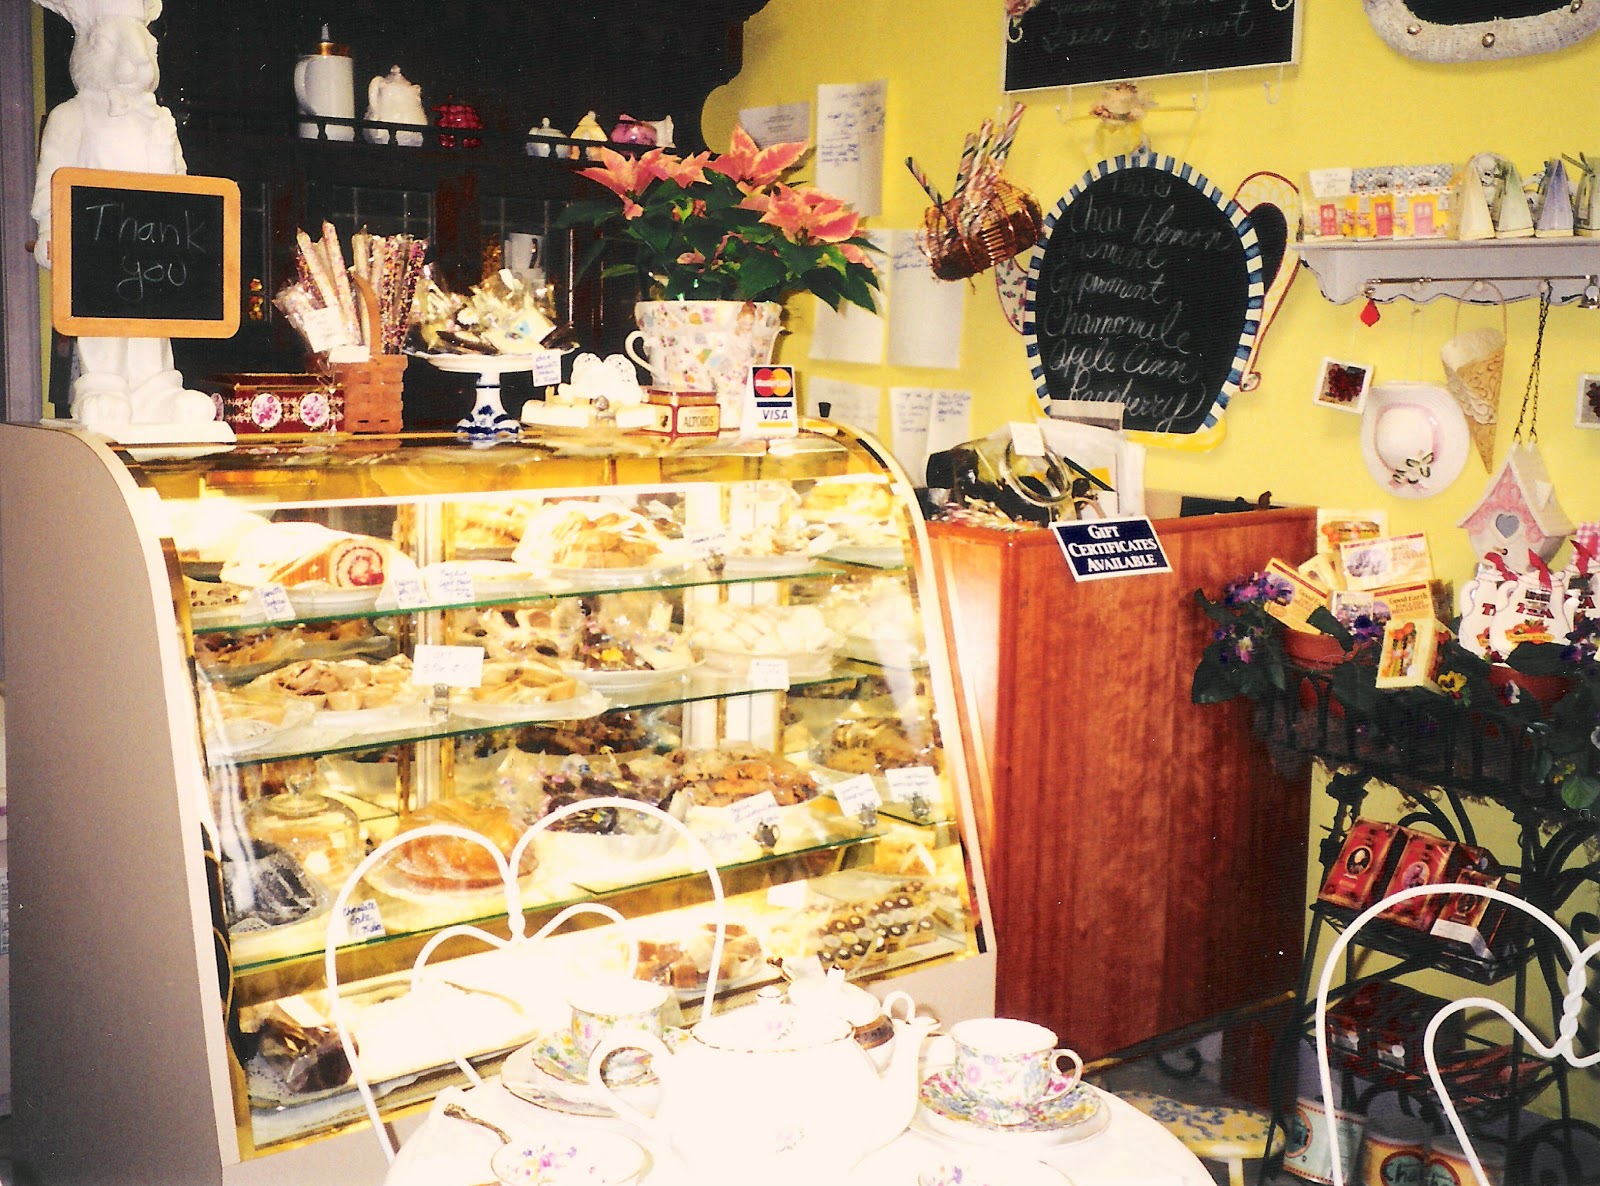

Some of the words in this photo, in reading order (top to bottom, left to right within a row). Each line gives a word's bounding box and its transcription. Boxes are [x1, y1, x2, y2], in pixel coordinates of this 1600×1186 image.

[86, 202, 207, 253] Thank
[1044, 299, 1191, 354] Chamomile
[1050, 337, 1116, 378] Apple
[683, 415, 715, 428] ALTOIDS
[763, 409, 789, 420] VISA
